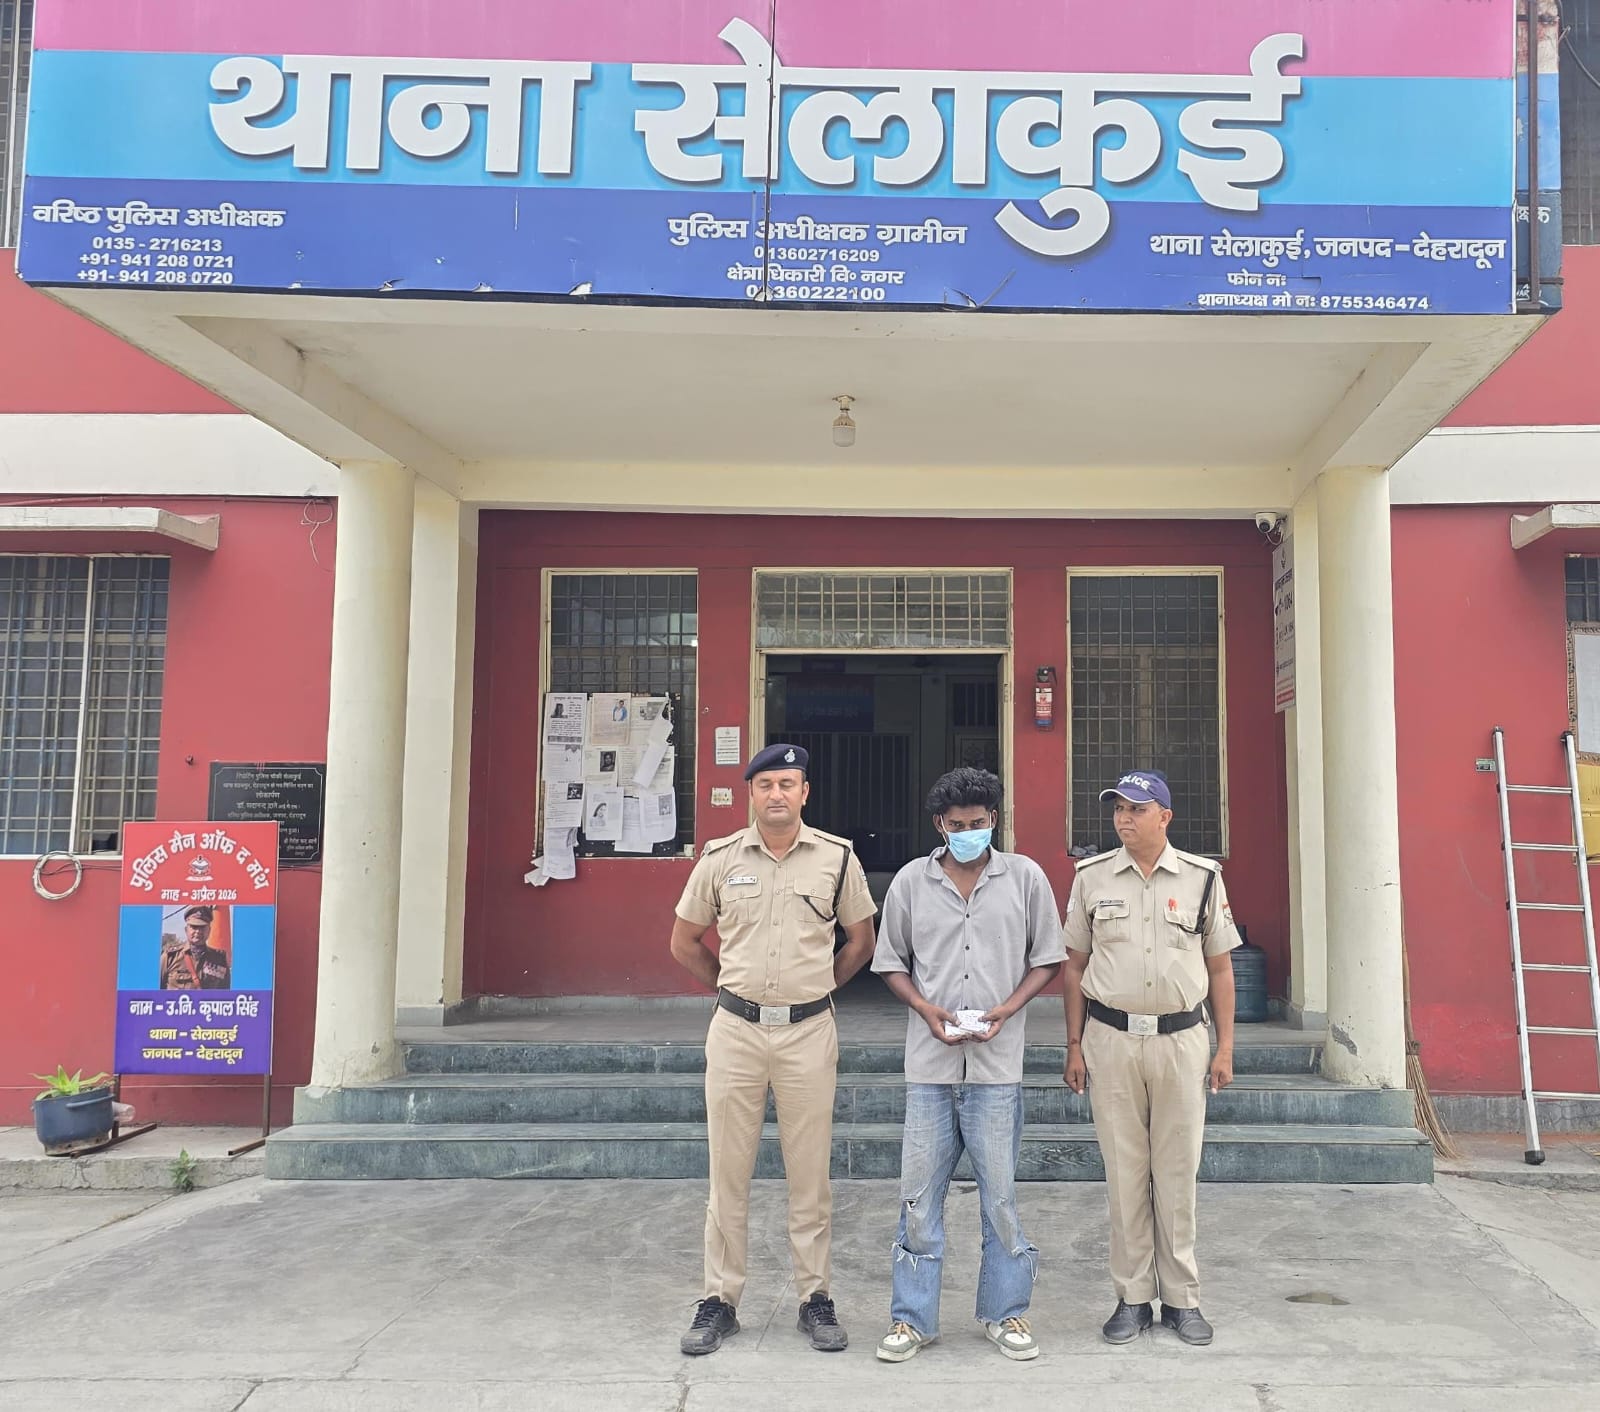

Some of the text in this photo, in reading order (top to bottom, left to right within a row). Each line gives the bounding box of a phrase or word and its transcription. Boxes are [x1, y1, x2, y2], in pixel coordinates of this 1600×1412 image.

[208, 17, 1304, 257] थाना सेलाकुई
[32, 199, 287, 233] वरिष्ठ पुलिस अधीक्षक
[667, 212, 968, 247] पुलिस अधीक्षक ग्रामीन
[92, 236, 135, 250] 0135
[148, 237, 222, 252] 2716213
[1150, 235, 1204, 255] थाना
[79, 252, 233, 268] +91- 941 208 0721
[77, 268, 233, 285] +91- 941 208 0720
[726, 262, 827, 284] क्षेत्राधिकारी
[860, 269, 906, 284] नगर
[1227, 268, 1264, 287] फोन
[745, 284, 886, 302] 0360222100
[1197, 293, 1269, 308] थानाध्यक्ष
[1271, 290, 1293, 307] मो
[1319, 295, 1429, 310] 8755346474
[130, 845, 169, 891] पुलिस
[199, 829, 237, 855] ऑफ
[236, 846, 252, 865] द
[246, 858, 270, 890] मंथ
[161, 888, 180, 901] माह
[217, 888, 237, 900] 2026
[130, 1000, 153, 1016] नाम
[199, 1000, 234, 1022] कृपाल
[236, 995, 259, 1017] सिंह
[150, 1028, 177, 1040] थाना
[190, 1024, 239, 1046] सेलाकुई
[142, 1048, 183, 1060] जनपद
[196, 1045, 244, 1065] देहरादून
